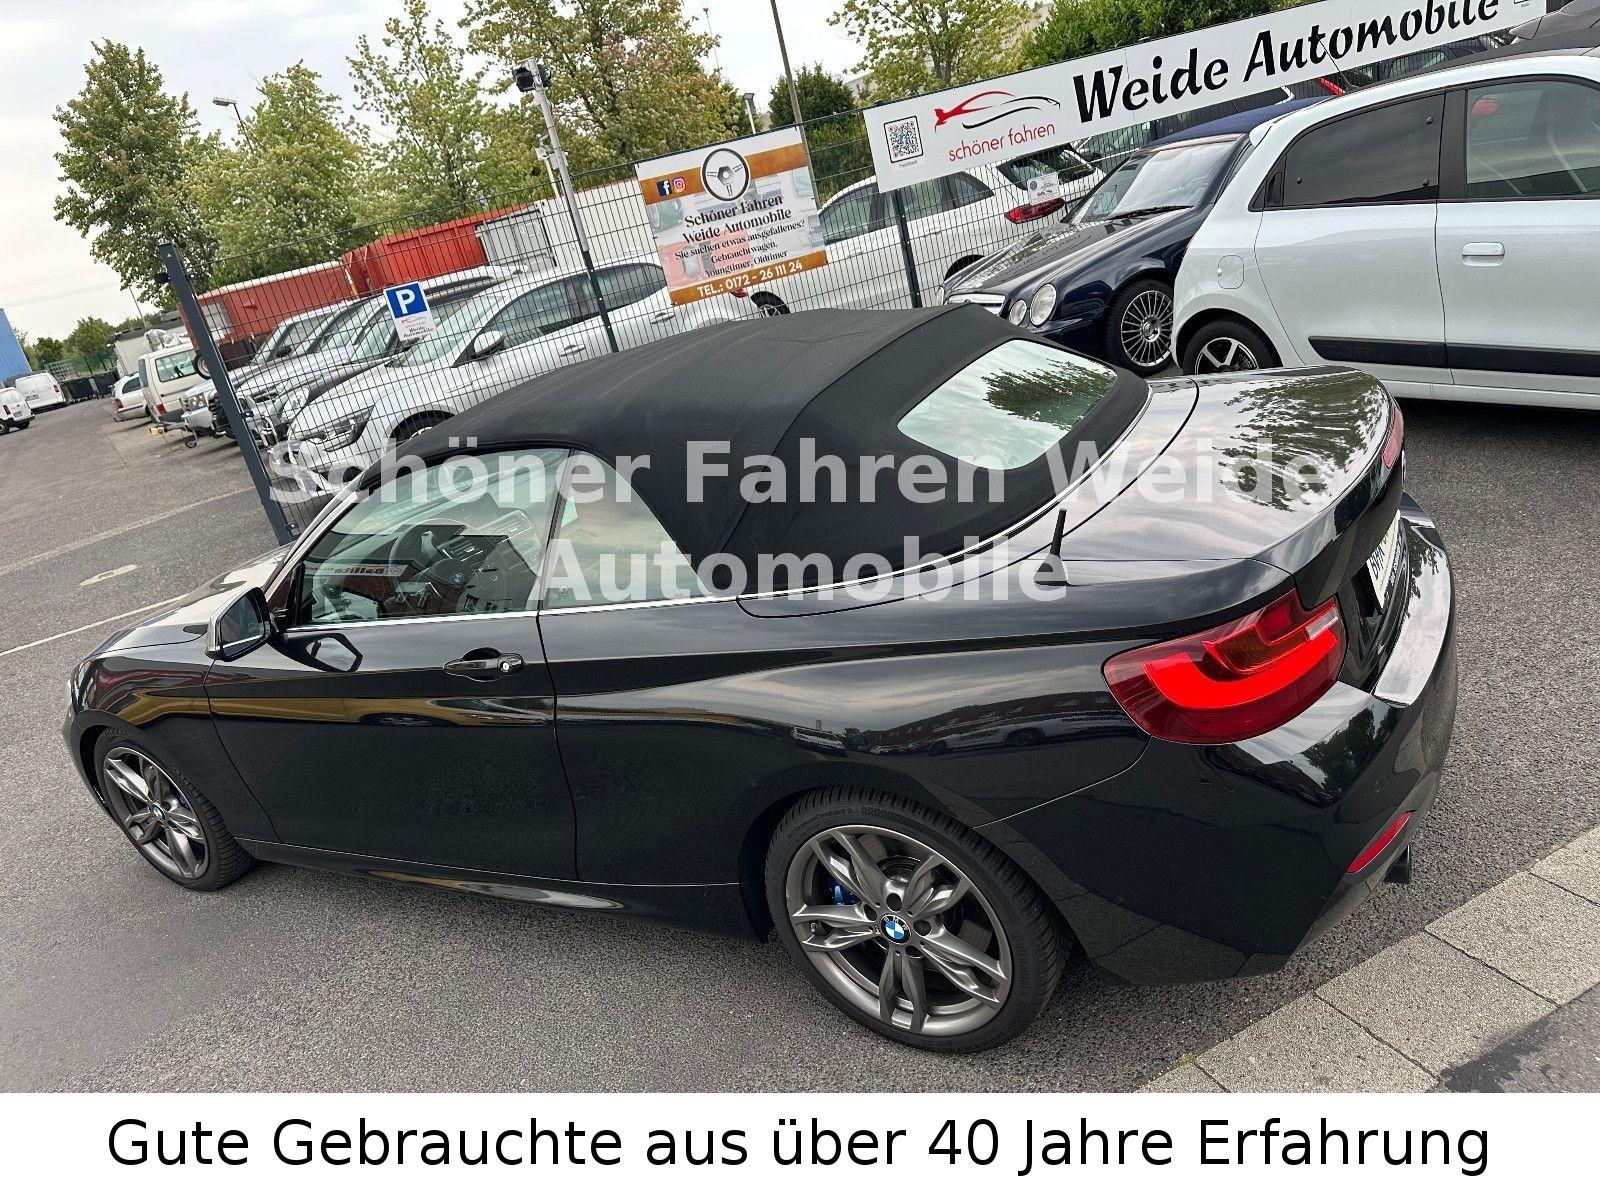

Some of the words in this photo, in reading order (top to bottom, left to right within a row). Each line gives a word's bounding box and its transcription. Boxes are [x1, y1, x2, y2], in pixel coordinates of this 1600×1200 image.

[1073, 48, 1229, 123] Weide
[1243, 0, 1498, 82] Automobile
[949, 136, 1005, 161] schöner
[1008, 123, 1056, 146] fahren
[682, 226, 721, 243] Weide
[723, 208, 792, 236] Automobile
[684, 206, 738, 228] Schöner
[740, 195, 783, 214] Fahren
[675, 249, 689, 260] Sie
[690, 242, 721, 256] suchen
[721, 236, 747, 248] etwas
[748, 219, 805, 241] ausgefallenes?
[697, 283, 723, 298] TEL.:
[725, 274, 751, 290] 0172
[760, 267, 774, 281] 26
[775, 263, 787, 277] 111
[788, 259, 803, 273] 24
[705, 260, 754, 277] Youngtimer,
[753, 250, 788, 265] Oldtimer
[395, 289, 416, 315] P
